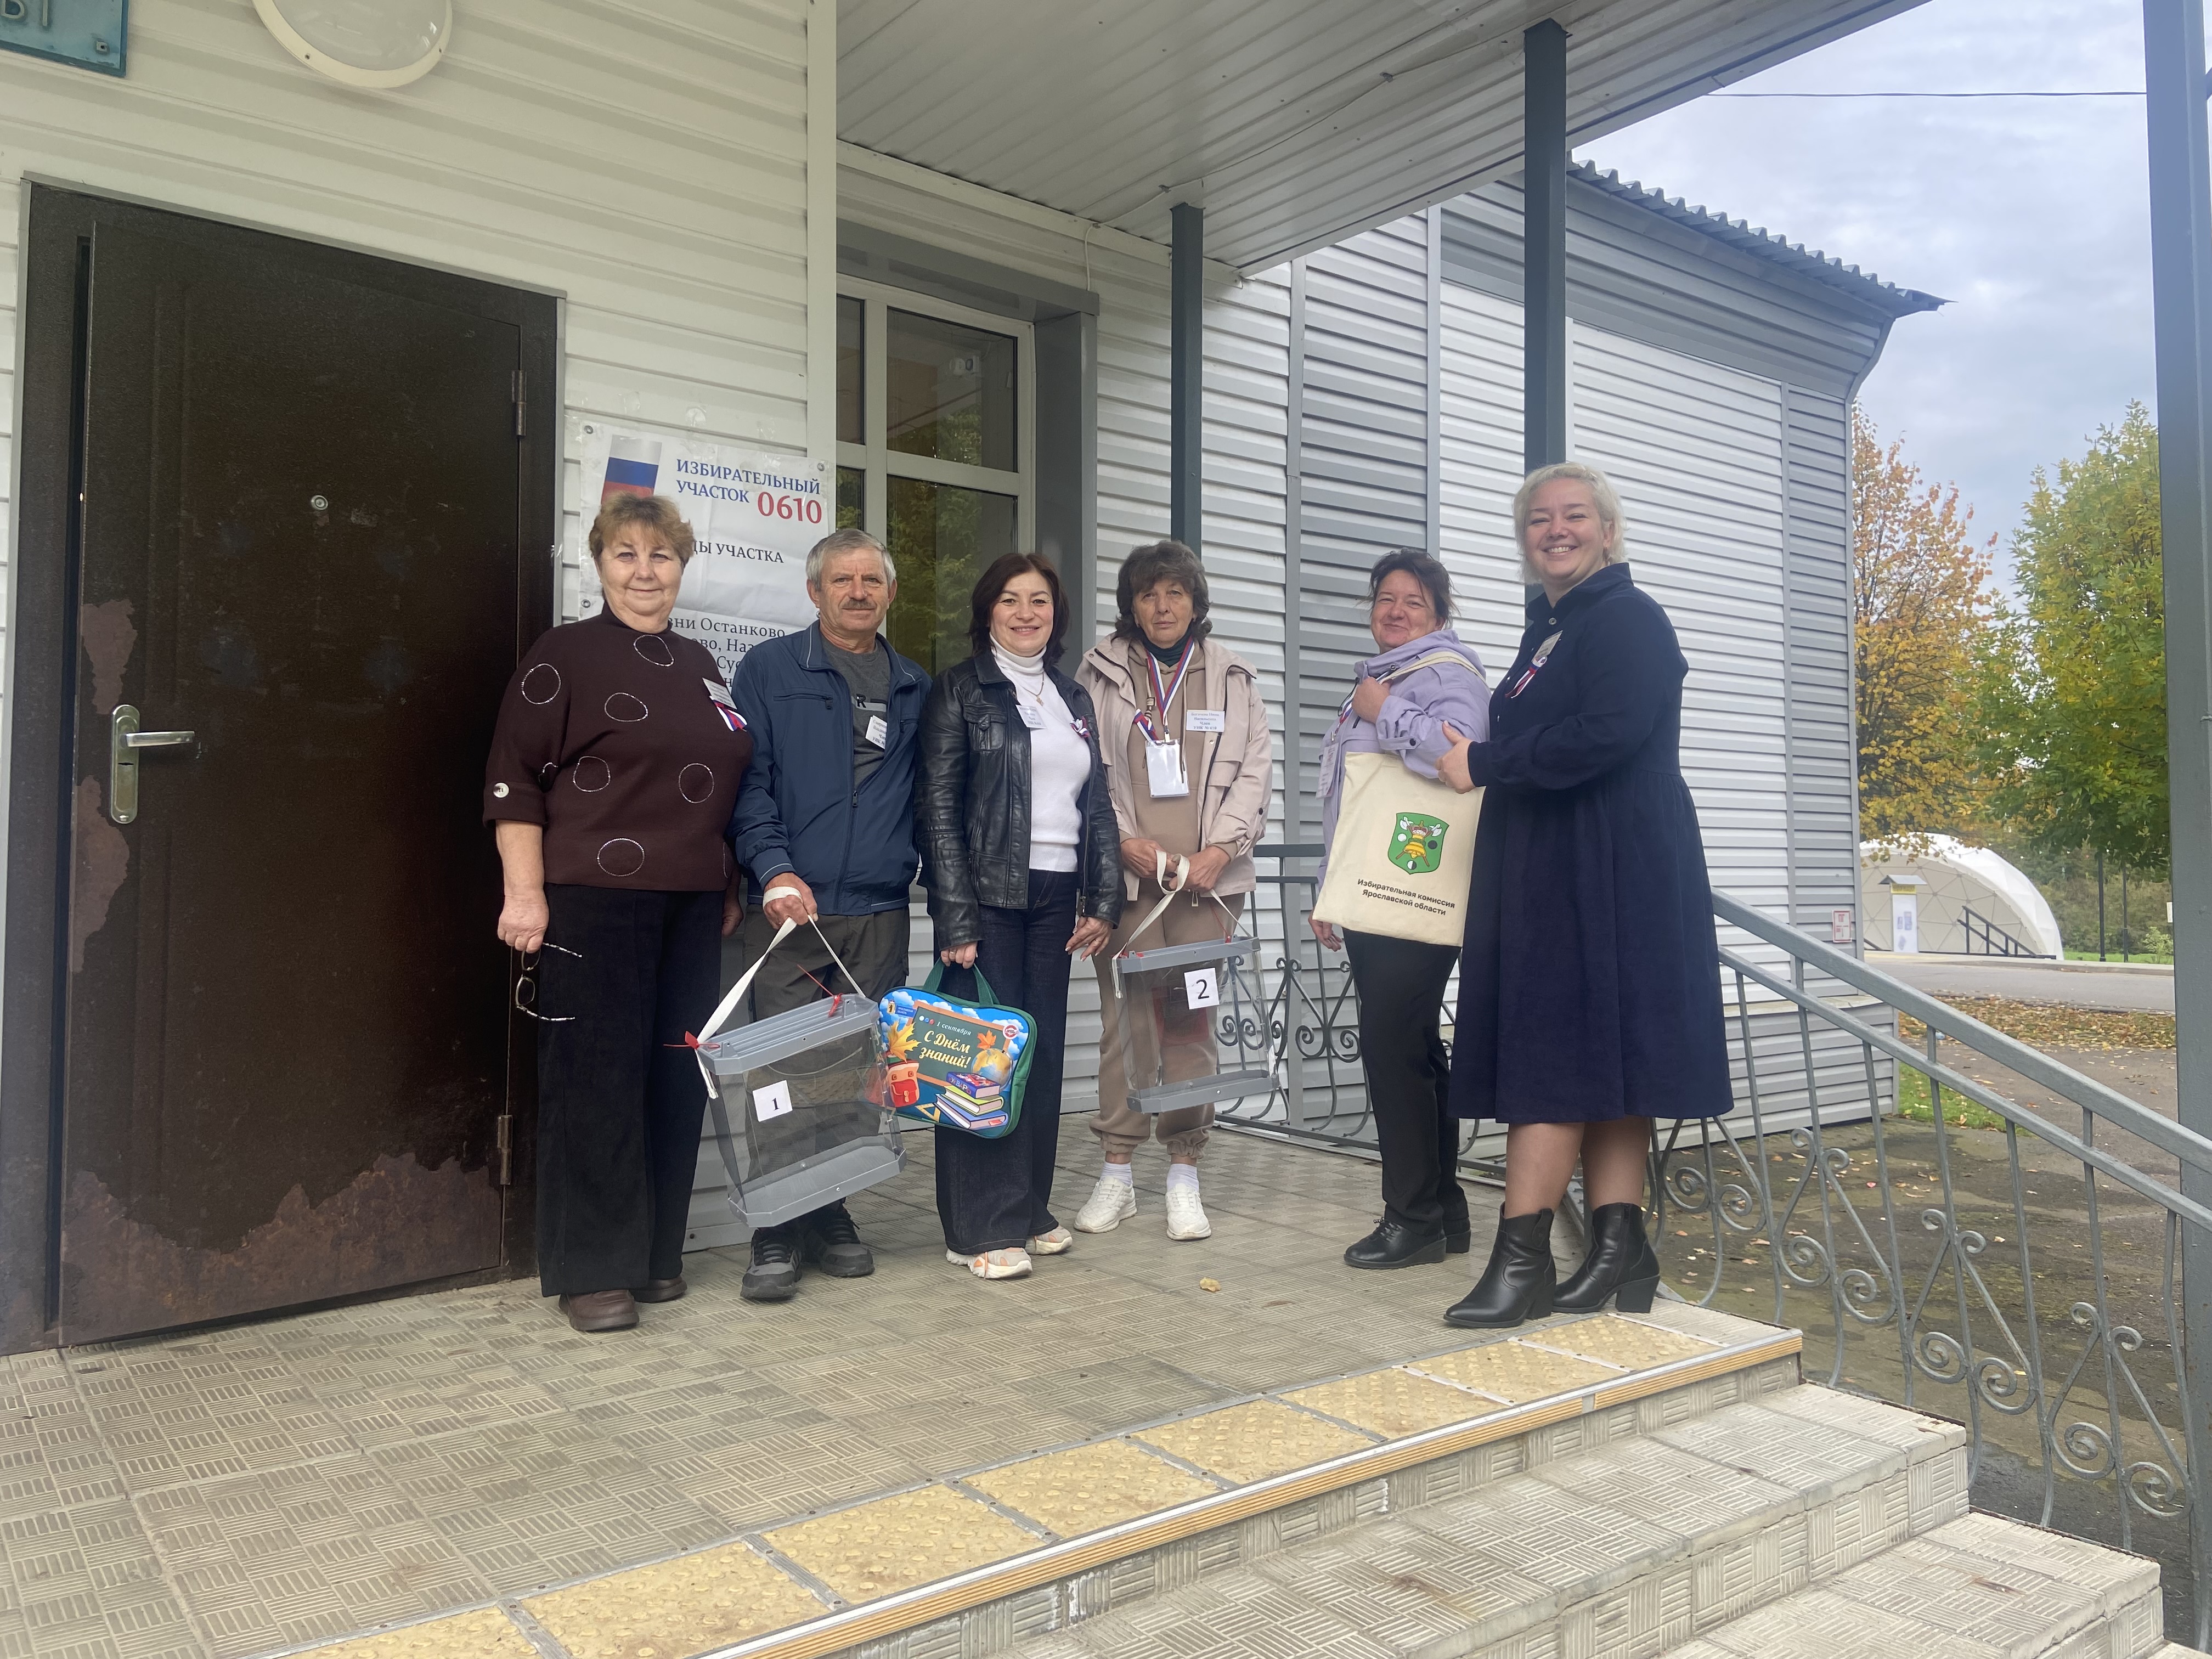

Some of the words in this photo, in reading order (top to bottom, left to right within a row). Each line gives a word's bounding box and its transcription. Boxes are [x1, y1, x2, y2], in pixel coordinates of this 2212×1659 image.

[676, 459, 820, 495] ИЗБИРАТЕЛЬНЫЙ
[676, 480, 750, 503] УЧАСТОК
[758, 492, 822, 524] 0610
[693, 540, 712, 555] Ы
[715, 543, 784, 563] УЧАСТКА
[1357, 878, 1417, 898] Избирательная
[1417, 894, 1455, 909] комиссия
[1362, 889, 1413, 906] Ярославской
[1414, 902, 1447, 916] области
[1196, 979, 1210, 1000] 2
[924, 1030, 934, 1042] С
[933, 1033, 970, 1053] Днём
[941, 1024, 972, 1036] сентября
[919, 1047, 972, 1068] знаний!
[772, 1097, 780, 1111] 1
